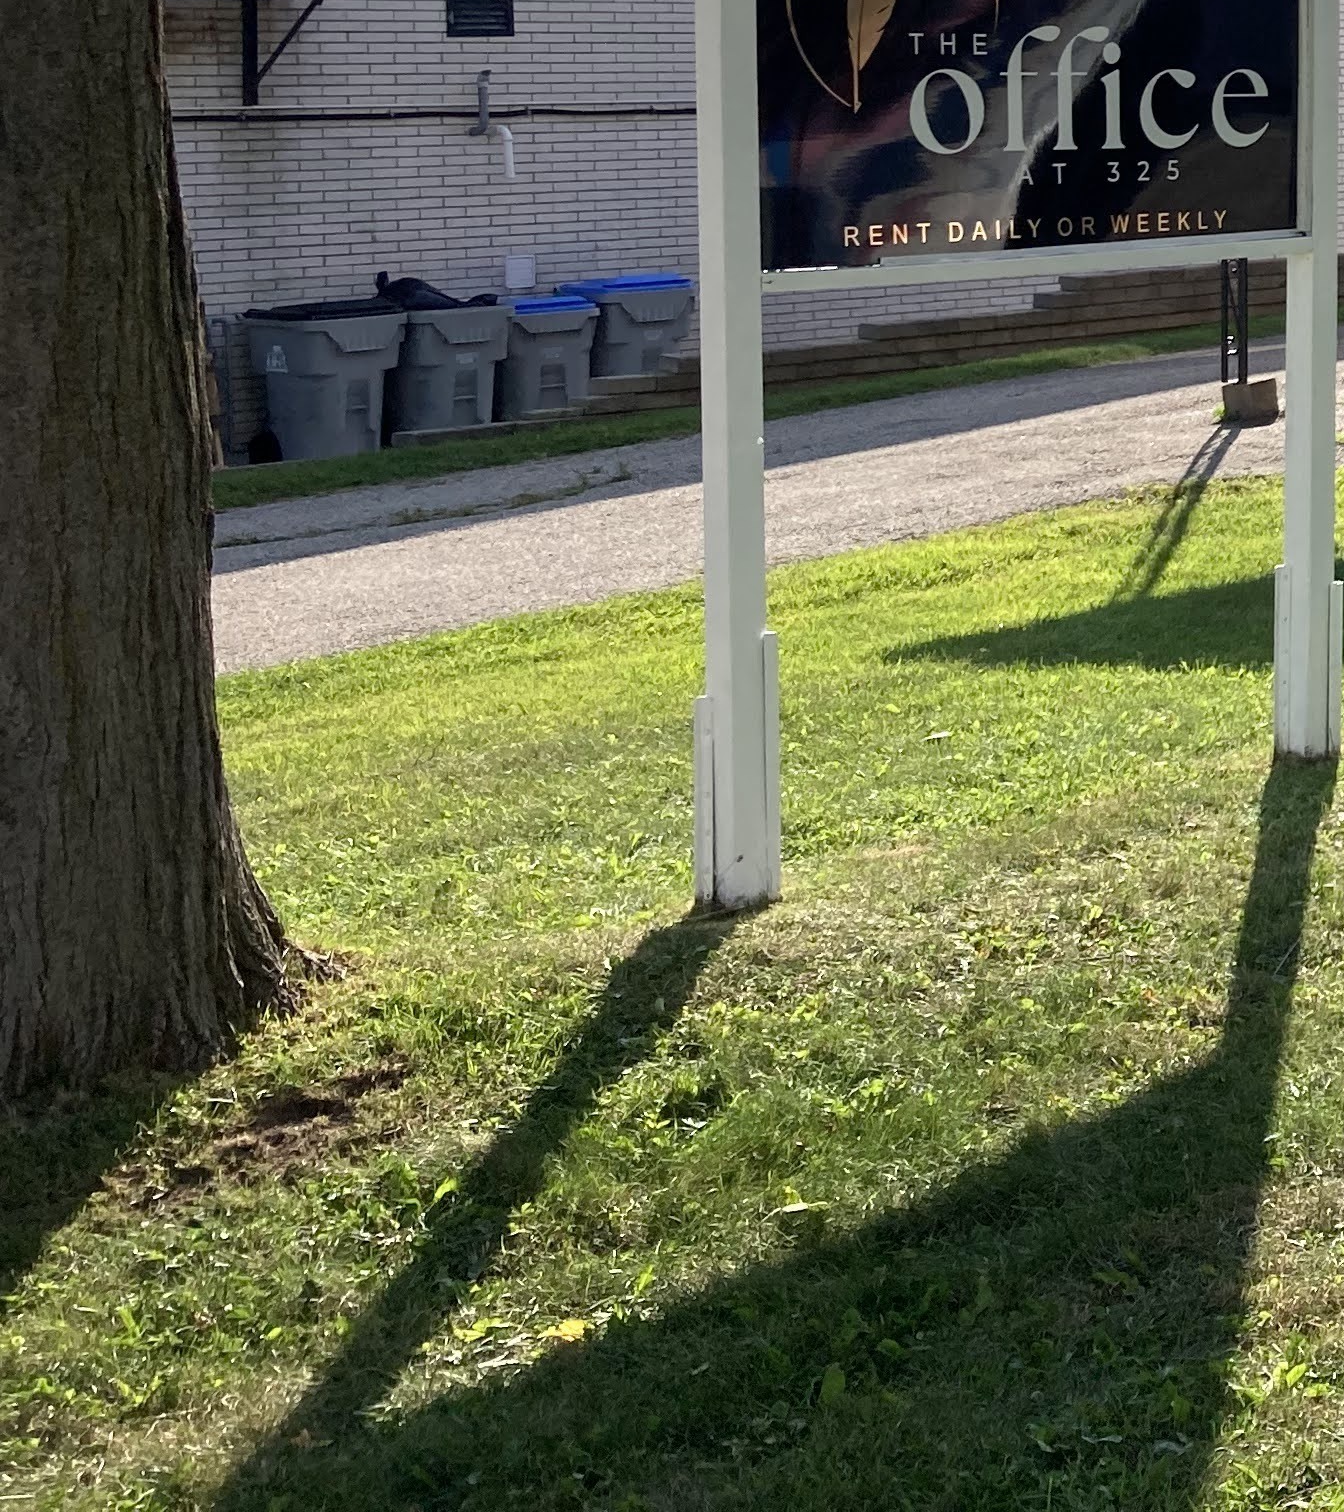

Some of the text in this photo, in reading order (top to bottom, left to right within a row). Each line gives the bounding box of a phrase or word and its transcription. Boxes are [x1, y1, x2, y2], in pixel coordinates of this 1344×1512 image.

[908, 32, 988, 56] THE
[908, 24, 1271, 155] office
[1019, 160, 1182, 186] AT 325
[843, 209, 1229, 247] RENT DAILY OR WEEKLY
